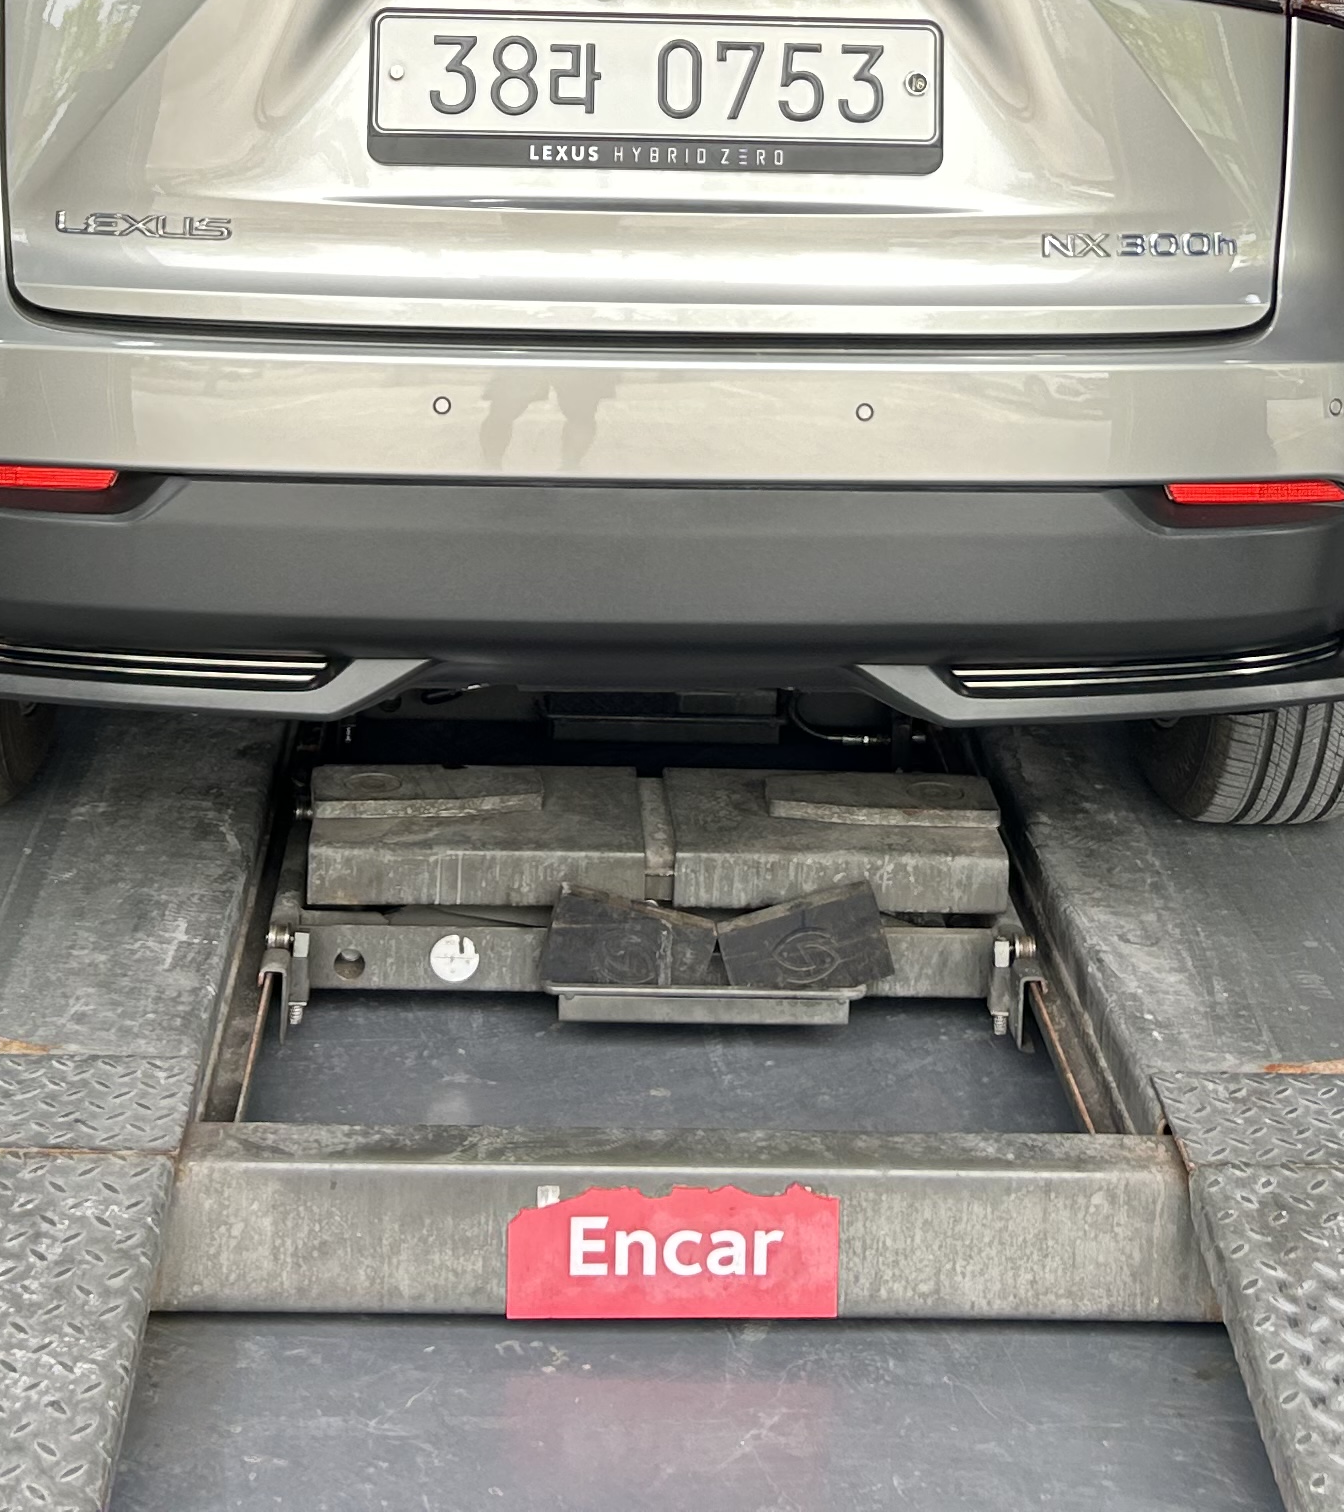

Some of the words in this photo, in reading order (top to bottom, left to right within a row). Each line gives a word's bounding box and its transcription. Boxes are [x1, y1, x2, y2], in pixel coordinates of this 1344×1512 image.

[429, 34, 602, 117] 38라
[656, 38, 885, 124] 0753
[529, 144, 600, 162] LEXUS
[613, 146, 707, 164] HYBRID
[720, 147, 784, 167] ZERO
[56, 210, 233, 241] LEXUS
[569, 1216, 784, 1276] Encar
